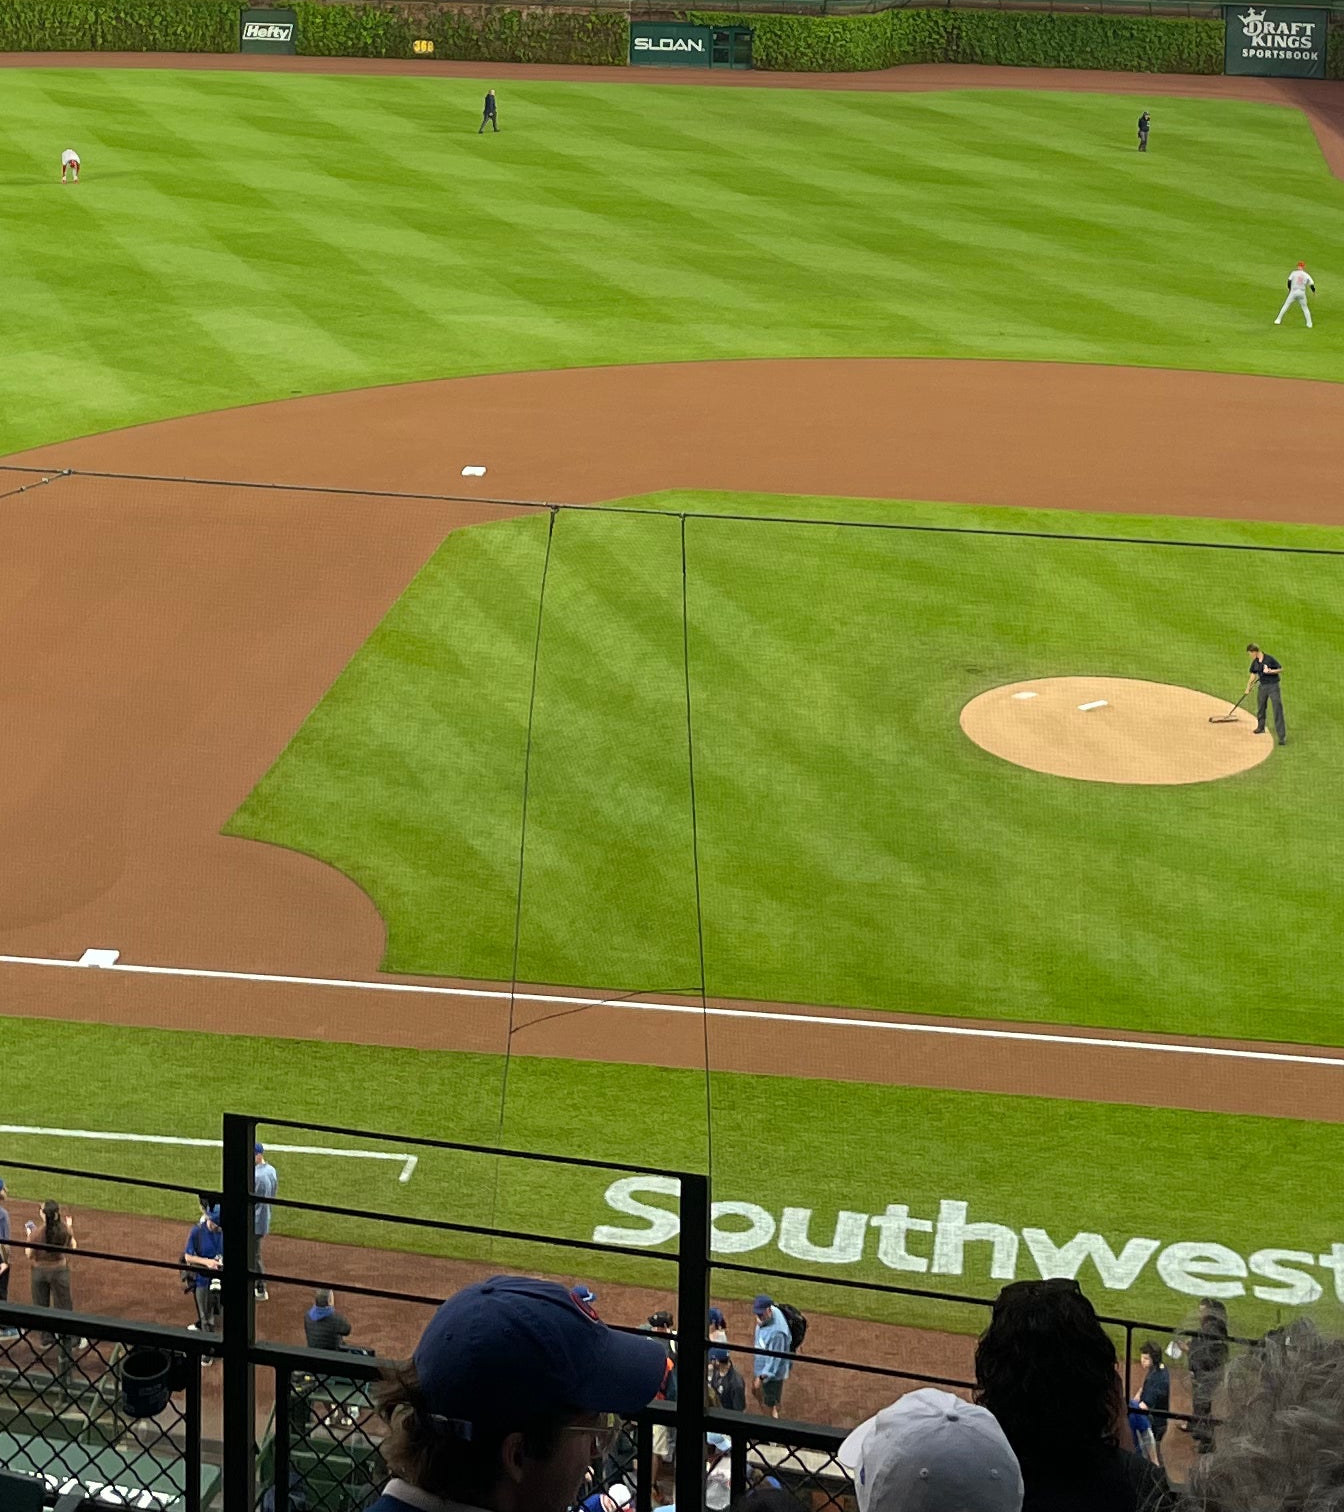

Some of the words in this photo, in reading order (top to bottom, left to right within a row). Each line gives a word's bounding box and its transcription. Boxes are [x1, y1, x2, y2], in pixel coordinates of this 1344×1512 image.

[246, 25, 289, 39] Hefty
[1242, 21, 1316, 36] DRAFT
[634, 37, 702, 52] SLOAN
[1251, 33, 1312, 48] KINGS
[1242, 49, 1318, 61] SPORTSBOOK
